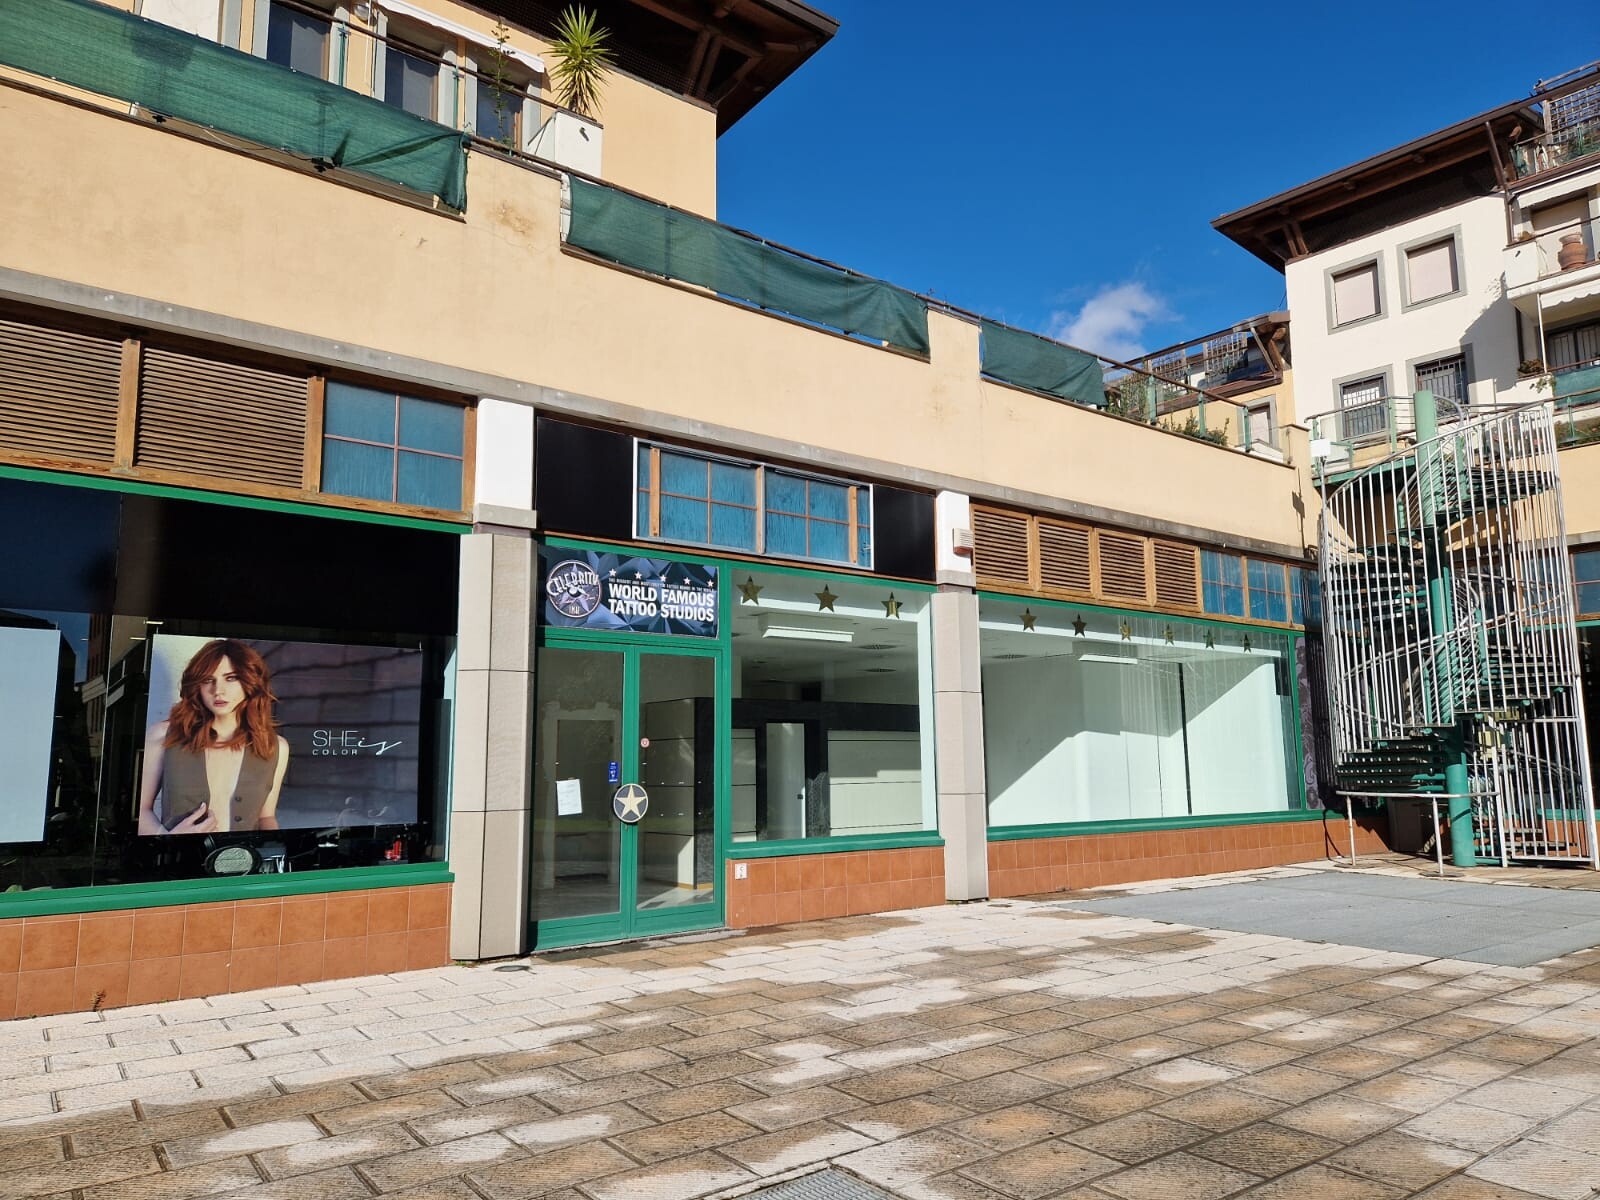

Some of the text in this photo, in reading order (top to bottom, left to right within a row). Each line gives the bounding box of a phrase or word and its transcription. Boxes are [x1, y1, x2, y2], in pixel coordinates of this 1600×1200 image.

[608, 583, 658, 602] WORLD
[661, 588, 715, 608] FAMOUS
[607, 598, 715, 622] TATTOO STUDIOS
[312, 748, 358, 757] COLOR
